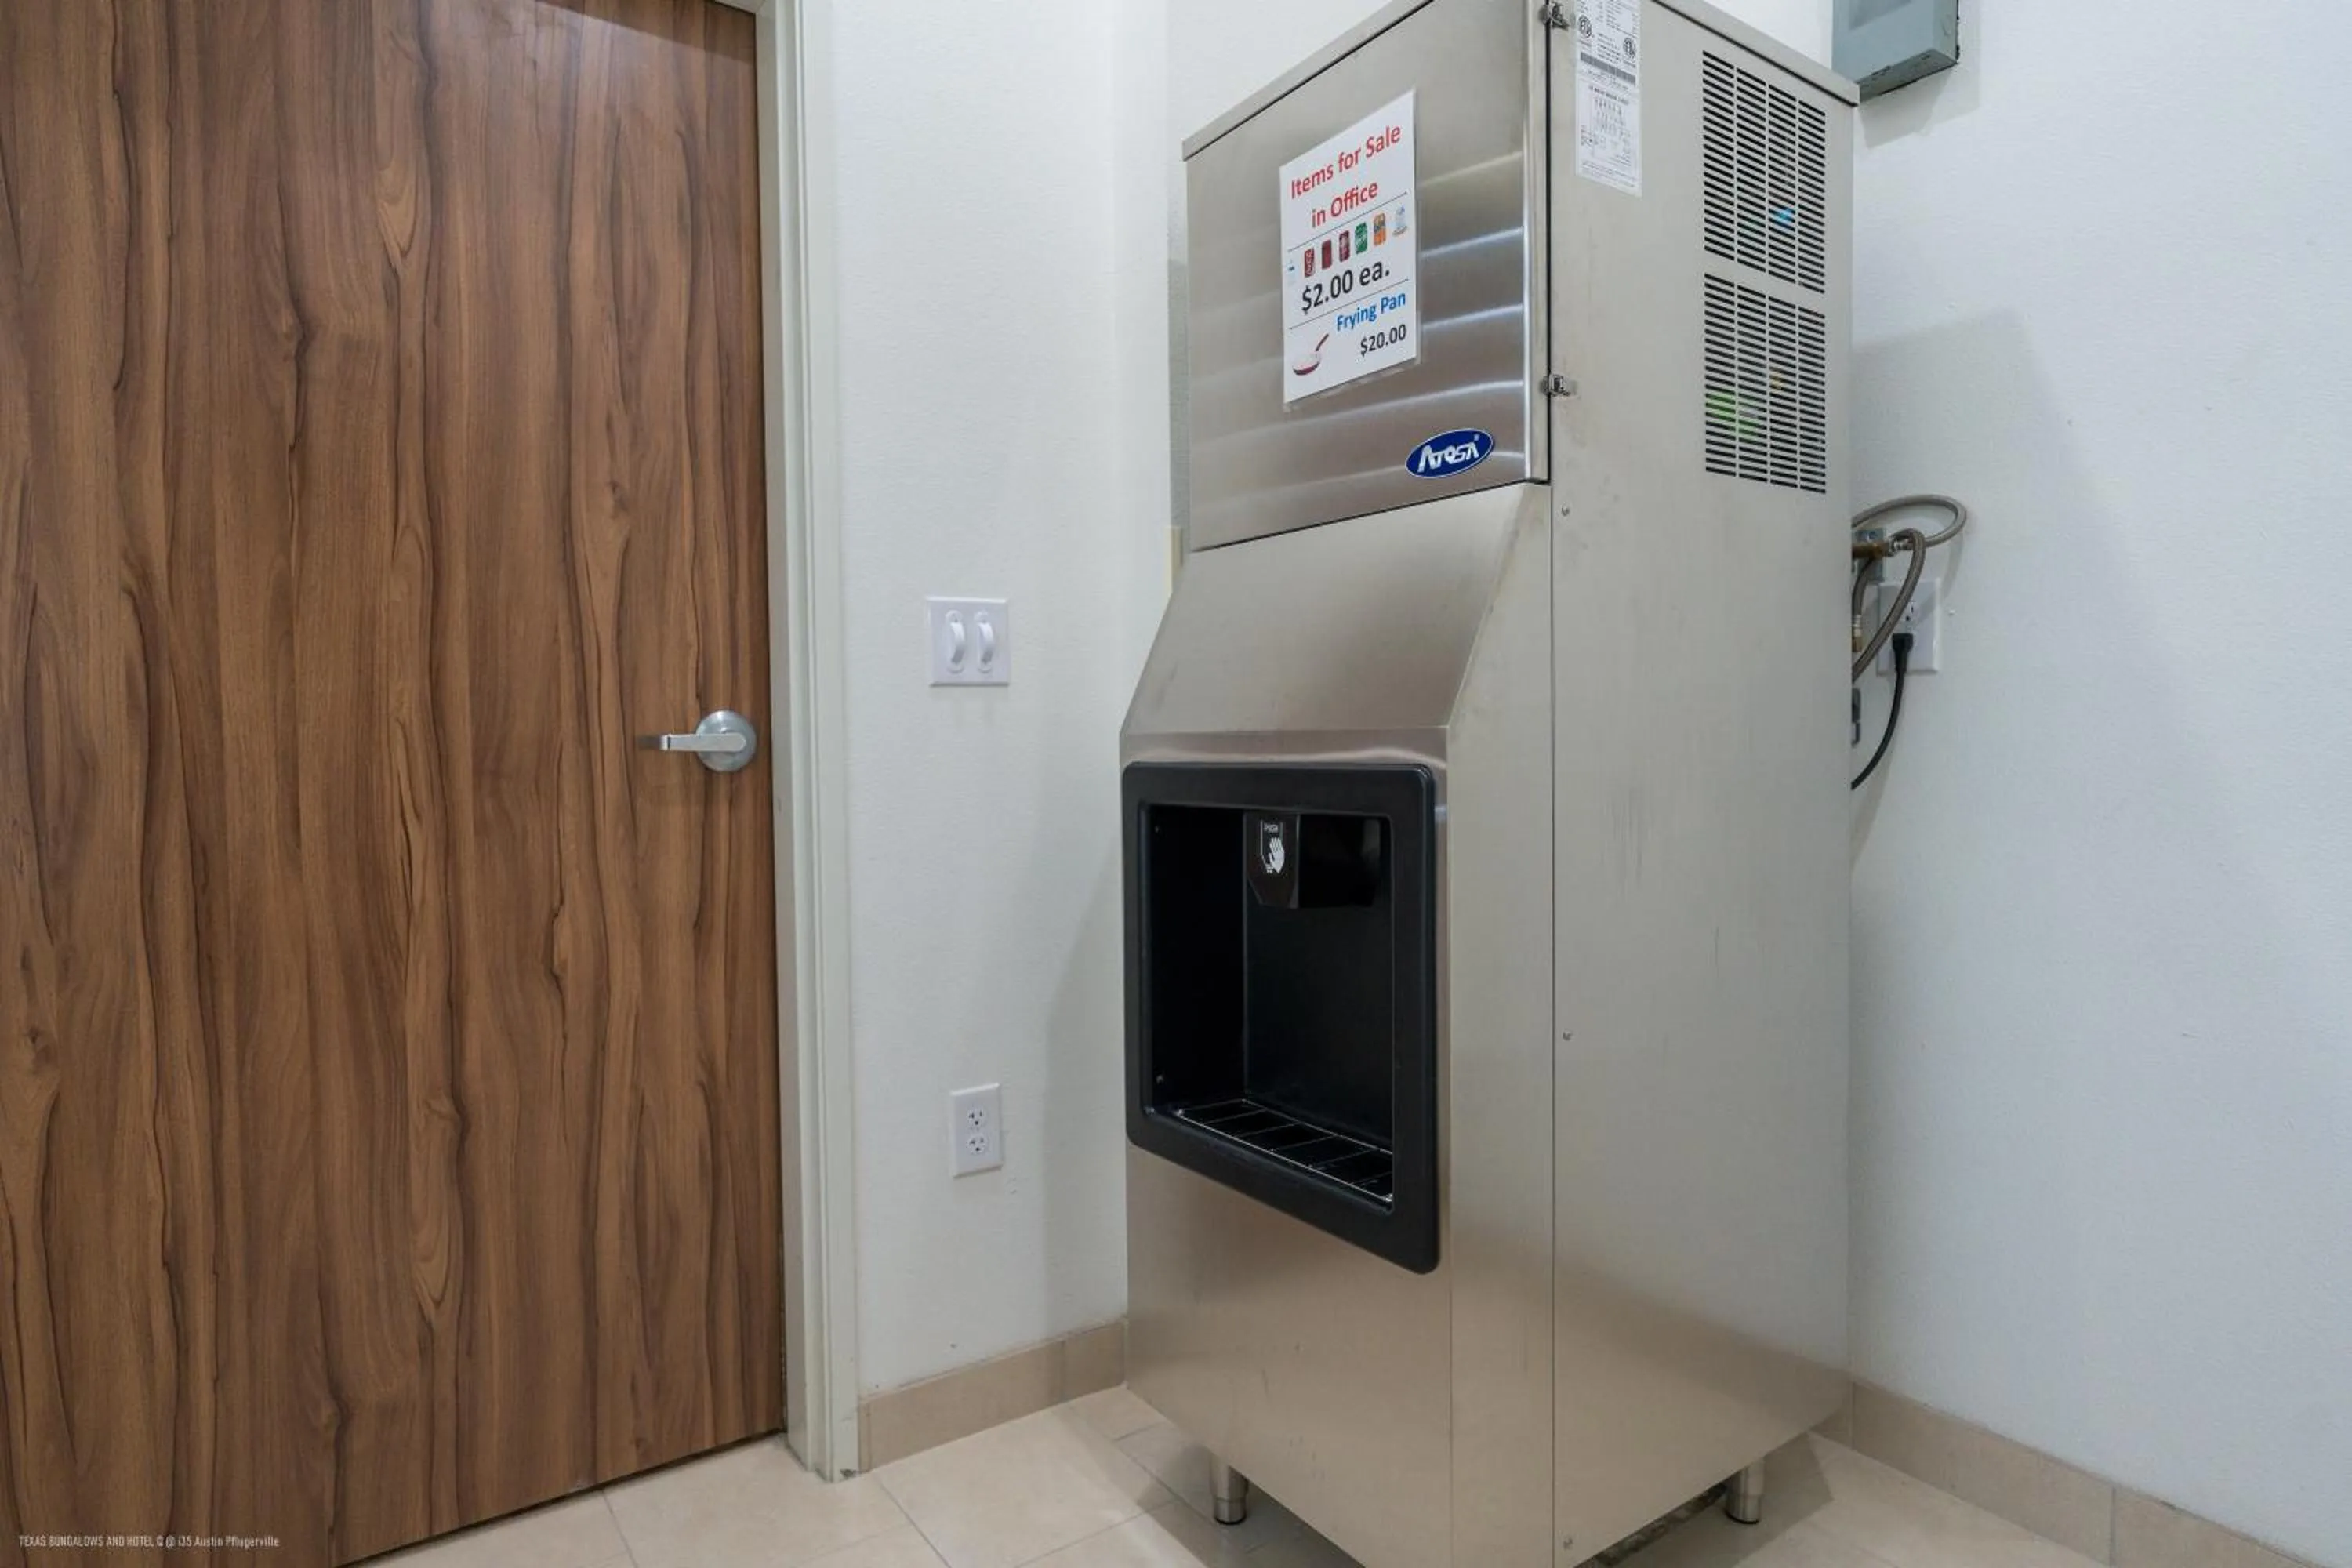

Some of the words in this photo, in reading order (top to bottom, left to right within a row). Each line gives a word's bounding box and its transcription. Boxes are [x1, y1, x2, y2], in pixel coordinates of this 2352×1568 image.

[1290, 164, 1334, 199] Items
[1338, 147, 1360, 175] for
[1366, 125, 1402, 158] Sale
[1312, 207, 1326, 228] in
[1330, 181, 1379, 220] Office
[1301, 268, 1353, 314] $2.00
[1359, 261, 1390, 287] ea.
[1336, 302, 1377, 332] Frying
[1381, 290, 1406, 315] Pan
[1359, 324, 1407, 357] $20.00
